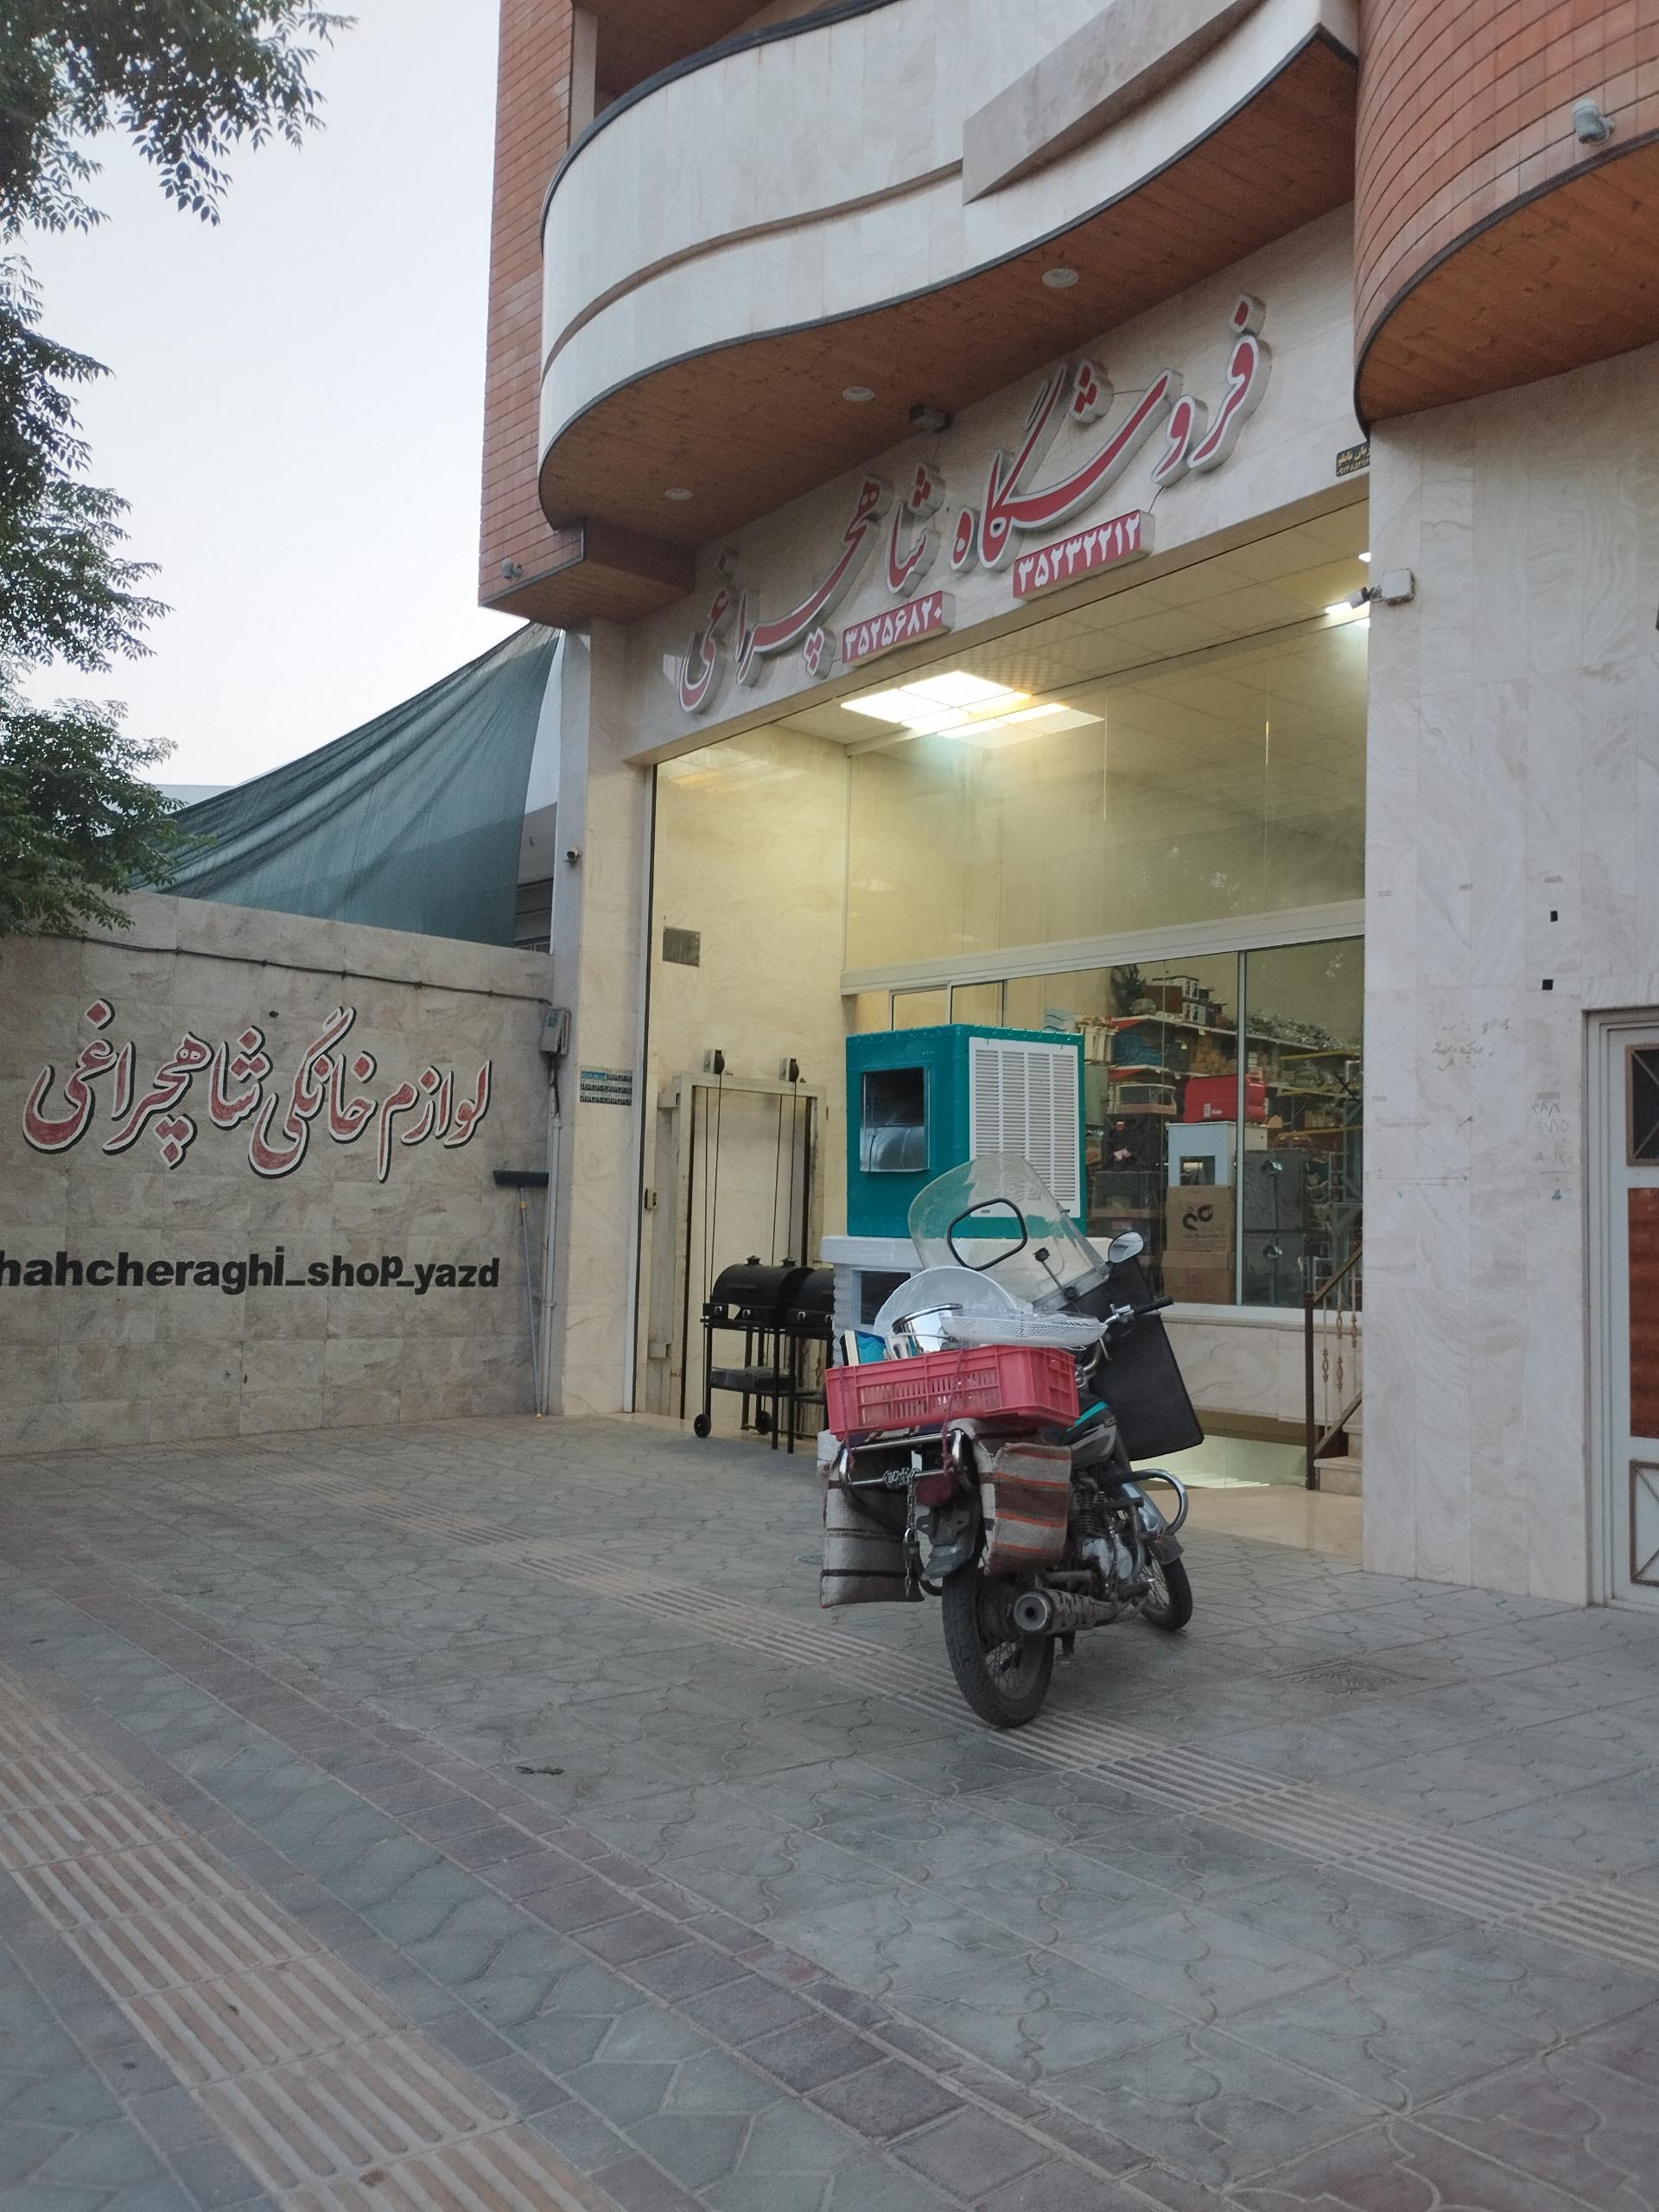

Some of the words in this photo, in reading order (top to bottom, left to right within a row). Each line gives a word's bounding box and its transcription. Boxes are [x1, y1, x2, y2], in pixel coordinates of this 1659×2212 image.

[949, 294, 1265, 571] فروشگاه
[679, 463, 943, 714] شاهچراغی
[844, 596, 943, 662] ۳۵۲۵۶۸۲۰
[1017, 512, 1141, 594] ۳۵۲۳۲۲۱۲
[22, 997, 273, 1170] شاهچراغی
[248, 1005, 378, 1180] خانگی
[376, 1059, 493, 1183] لوازم
